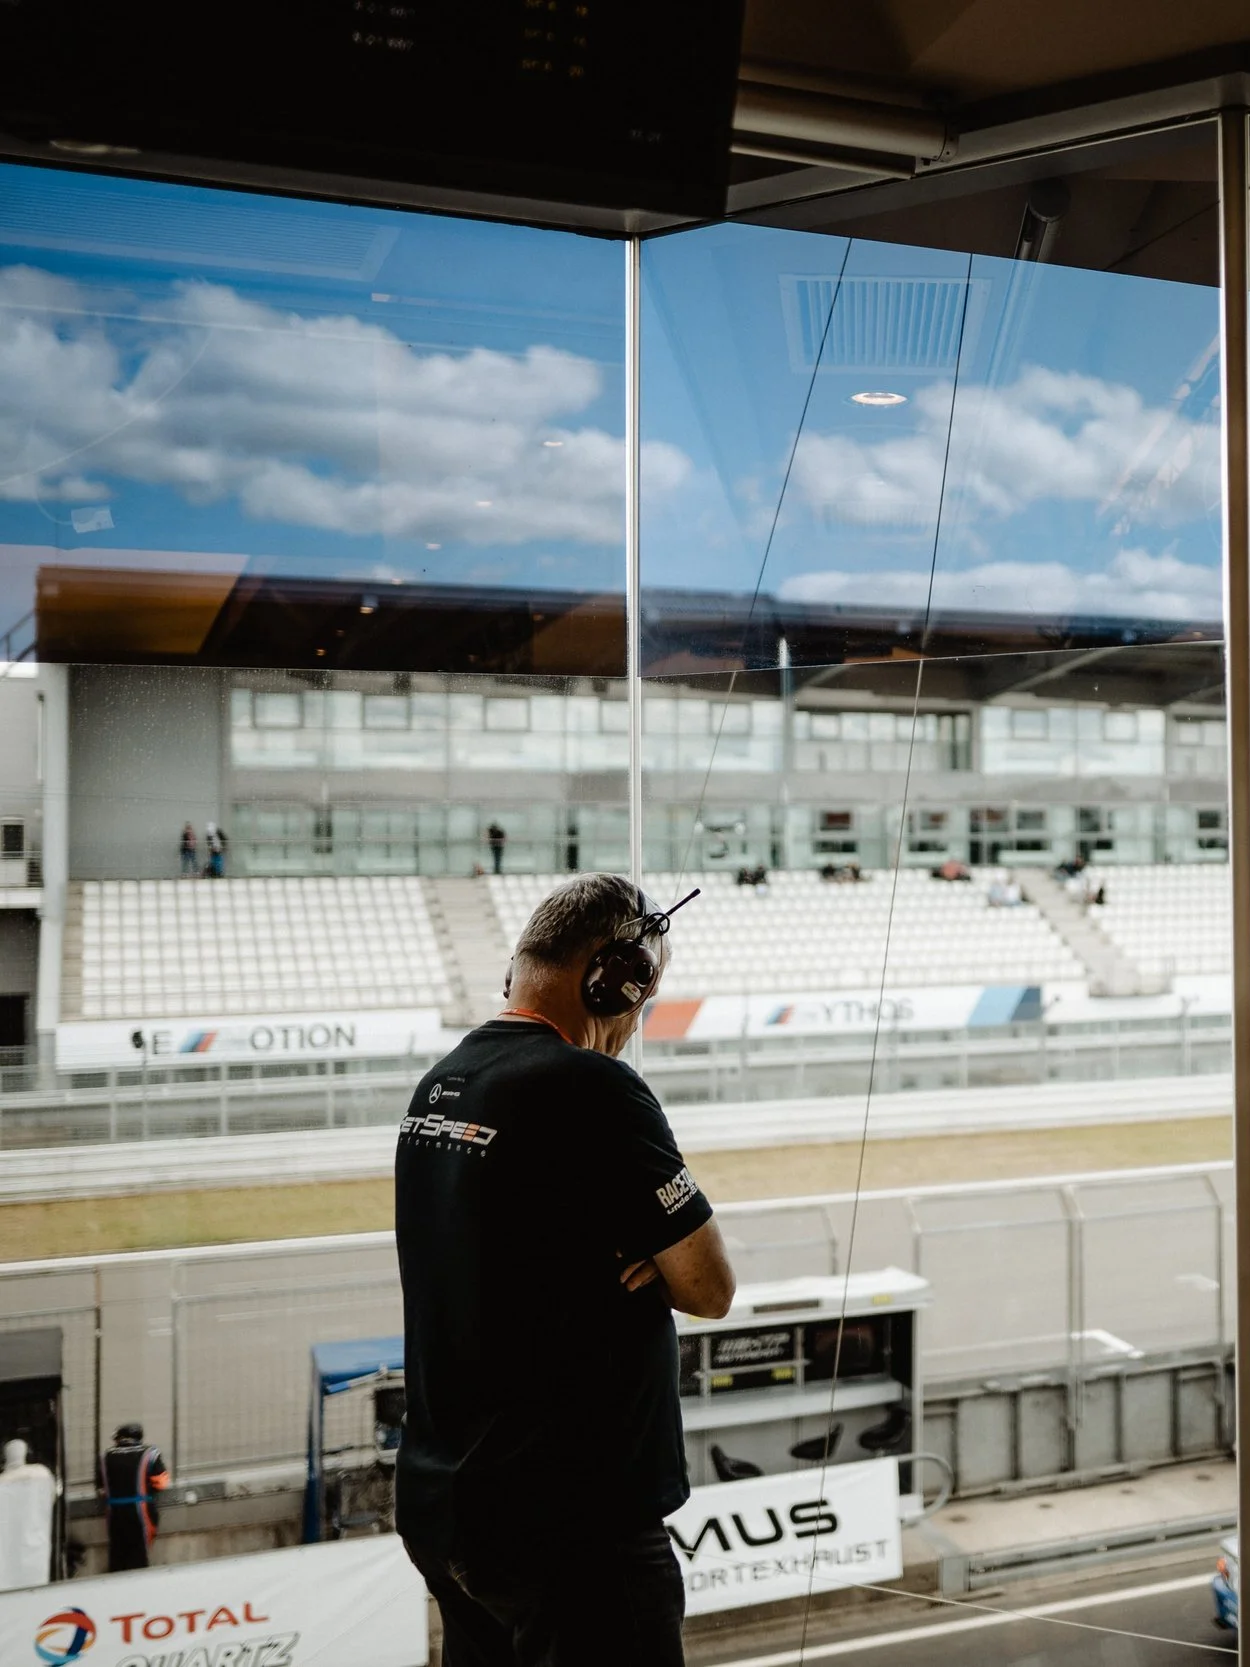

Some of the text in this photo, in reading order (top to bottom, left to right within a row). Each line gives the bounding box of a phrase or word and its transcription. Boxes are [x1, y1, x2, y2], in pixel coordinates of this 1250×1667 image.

[802, 996, 914, 1024] YTHOS
[226, 1023, 356, 1053] OTION
[401, 1112, 498, 1145] ETSPEED
[664, 1498, 839, 1561] MUS
[686, 1538, 889, 1593] ORTEXHAUST
[109, 1601, 270, 1644] TOTAL
